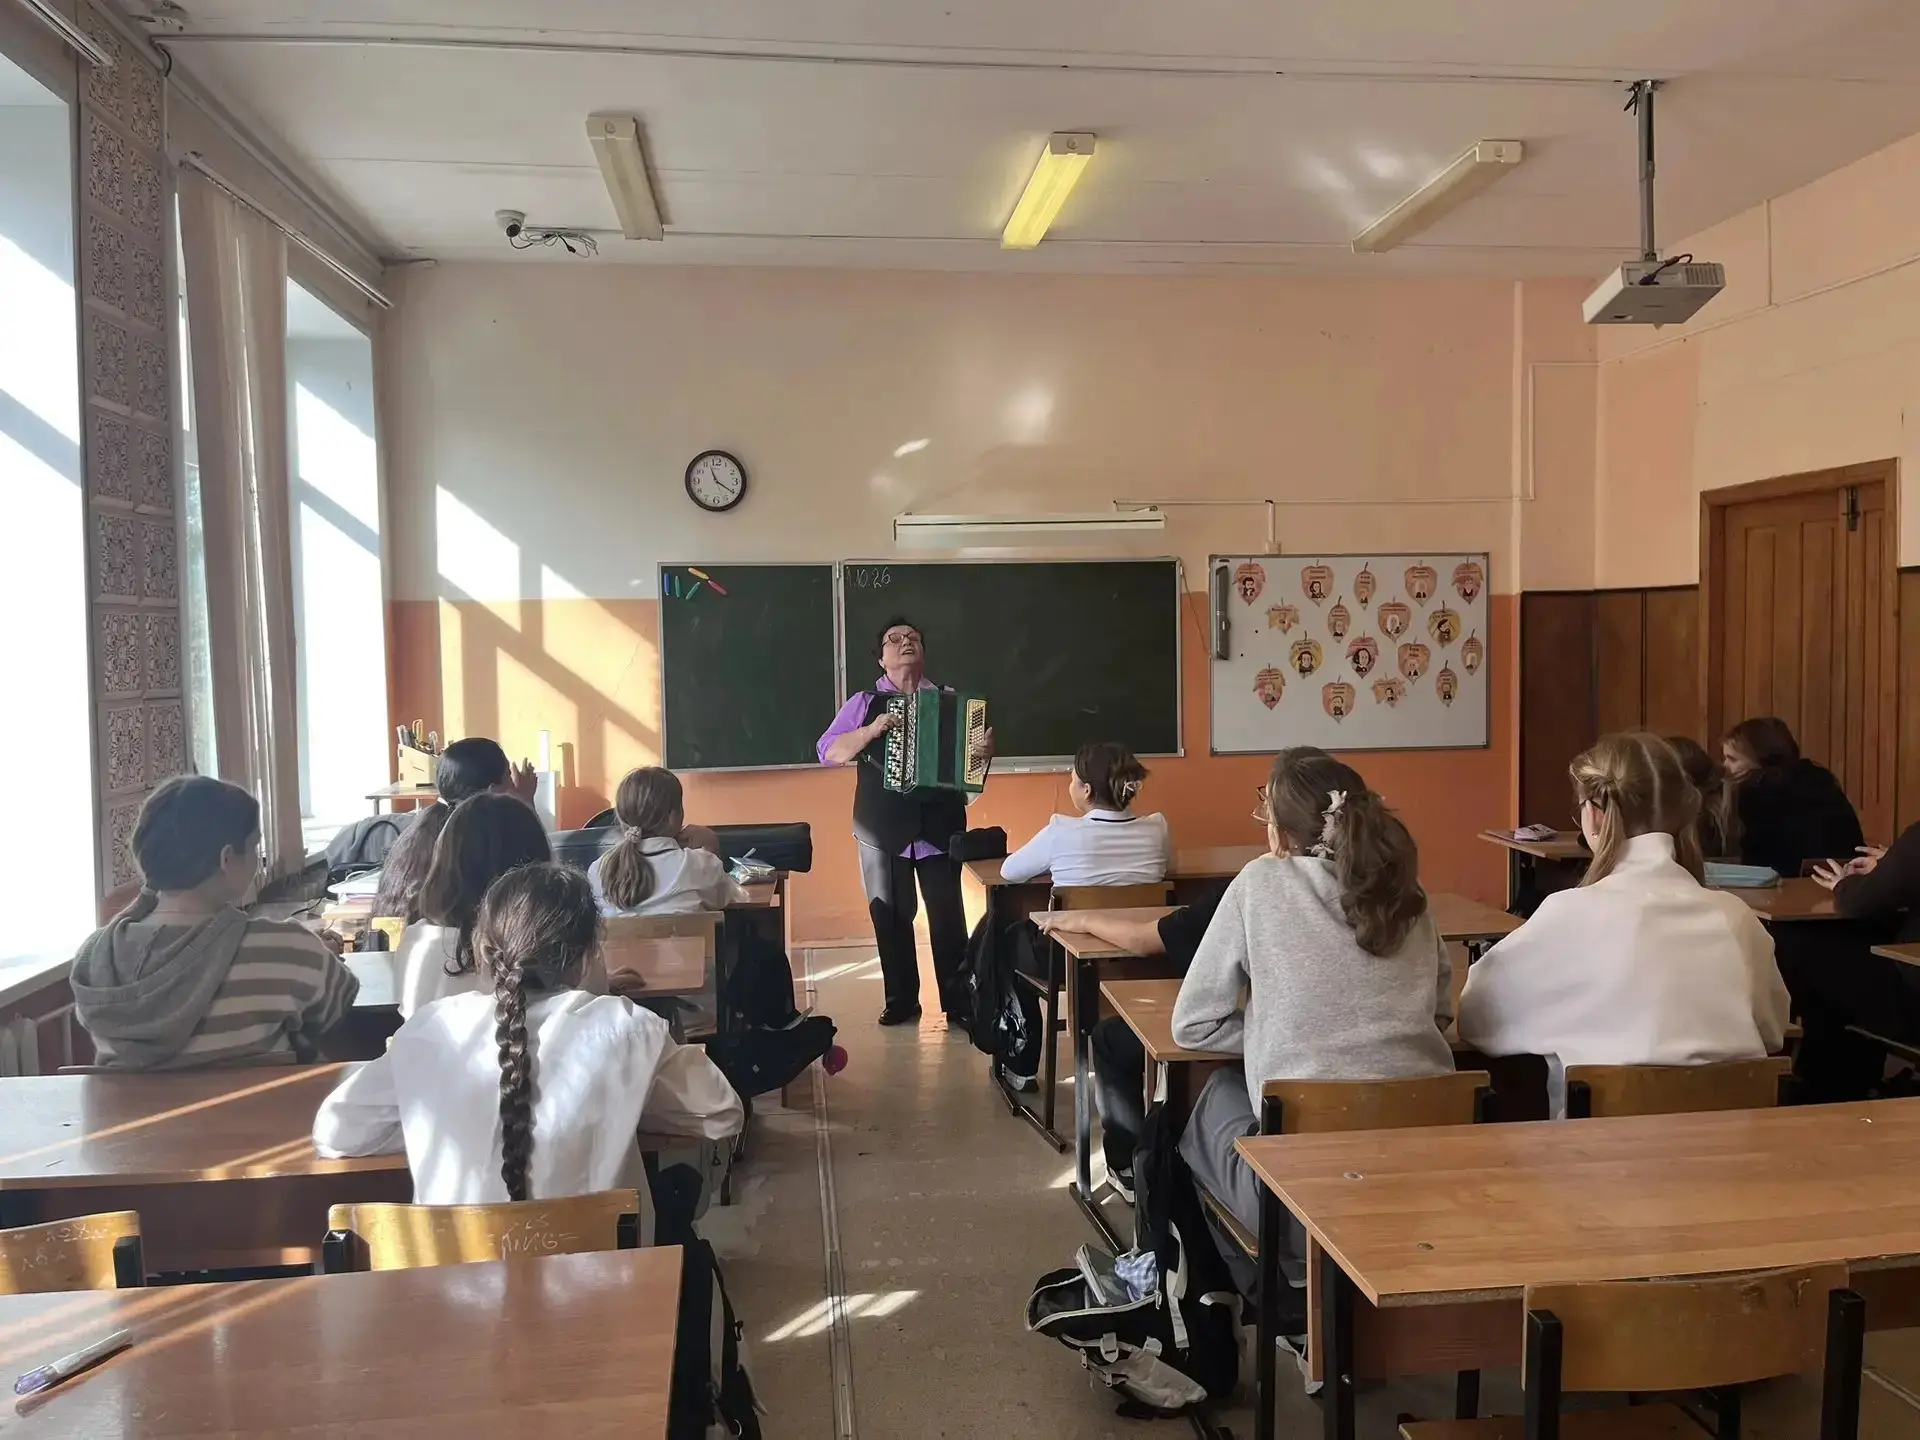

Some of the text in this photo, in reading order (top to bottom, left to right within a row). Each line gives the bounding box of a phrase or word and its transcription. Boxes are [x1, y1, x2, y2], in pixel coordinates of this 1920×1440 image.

[711, 457, 722, 466] 12
[693, 477, 700, 485] 9
[732, 477, 739, 486] 3
[713, 496, 720, 504] 6
